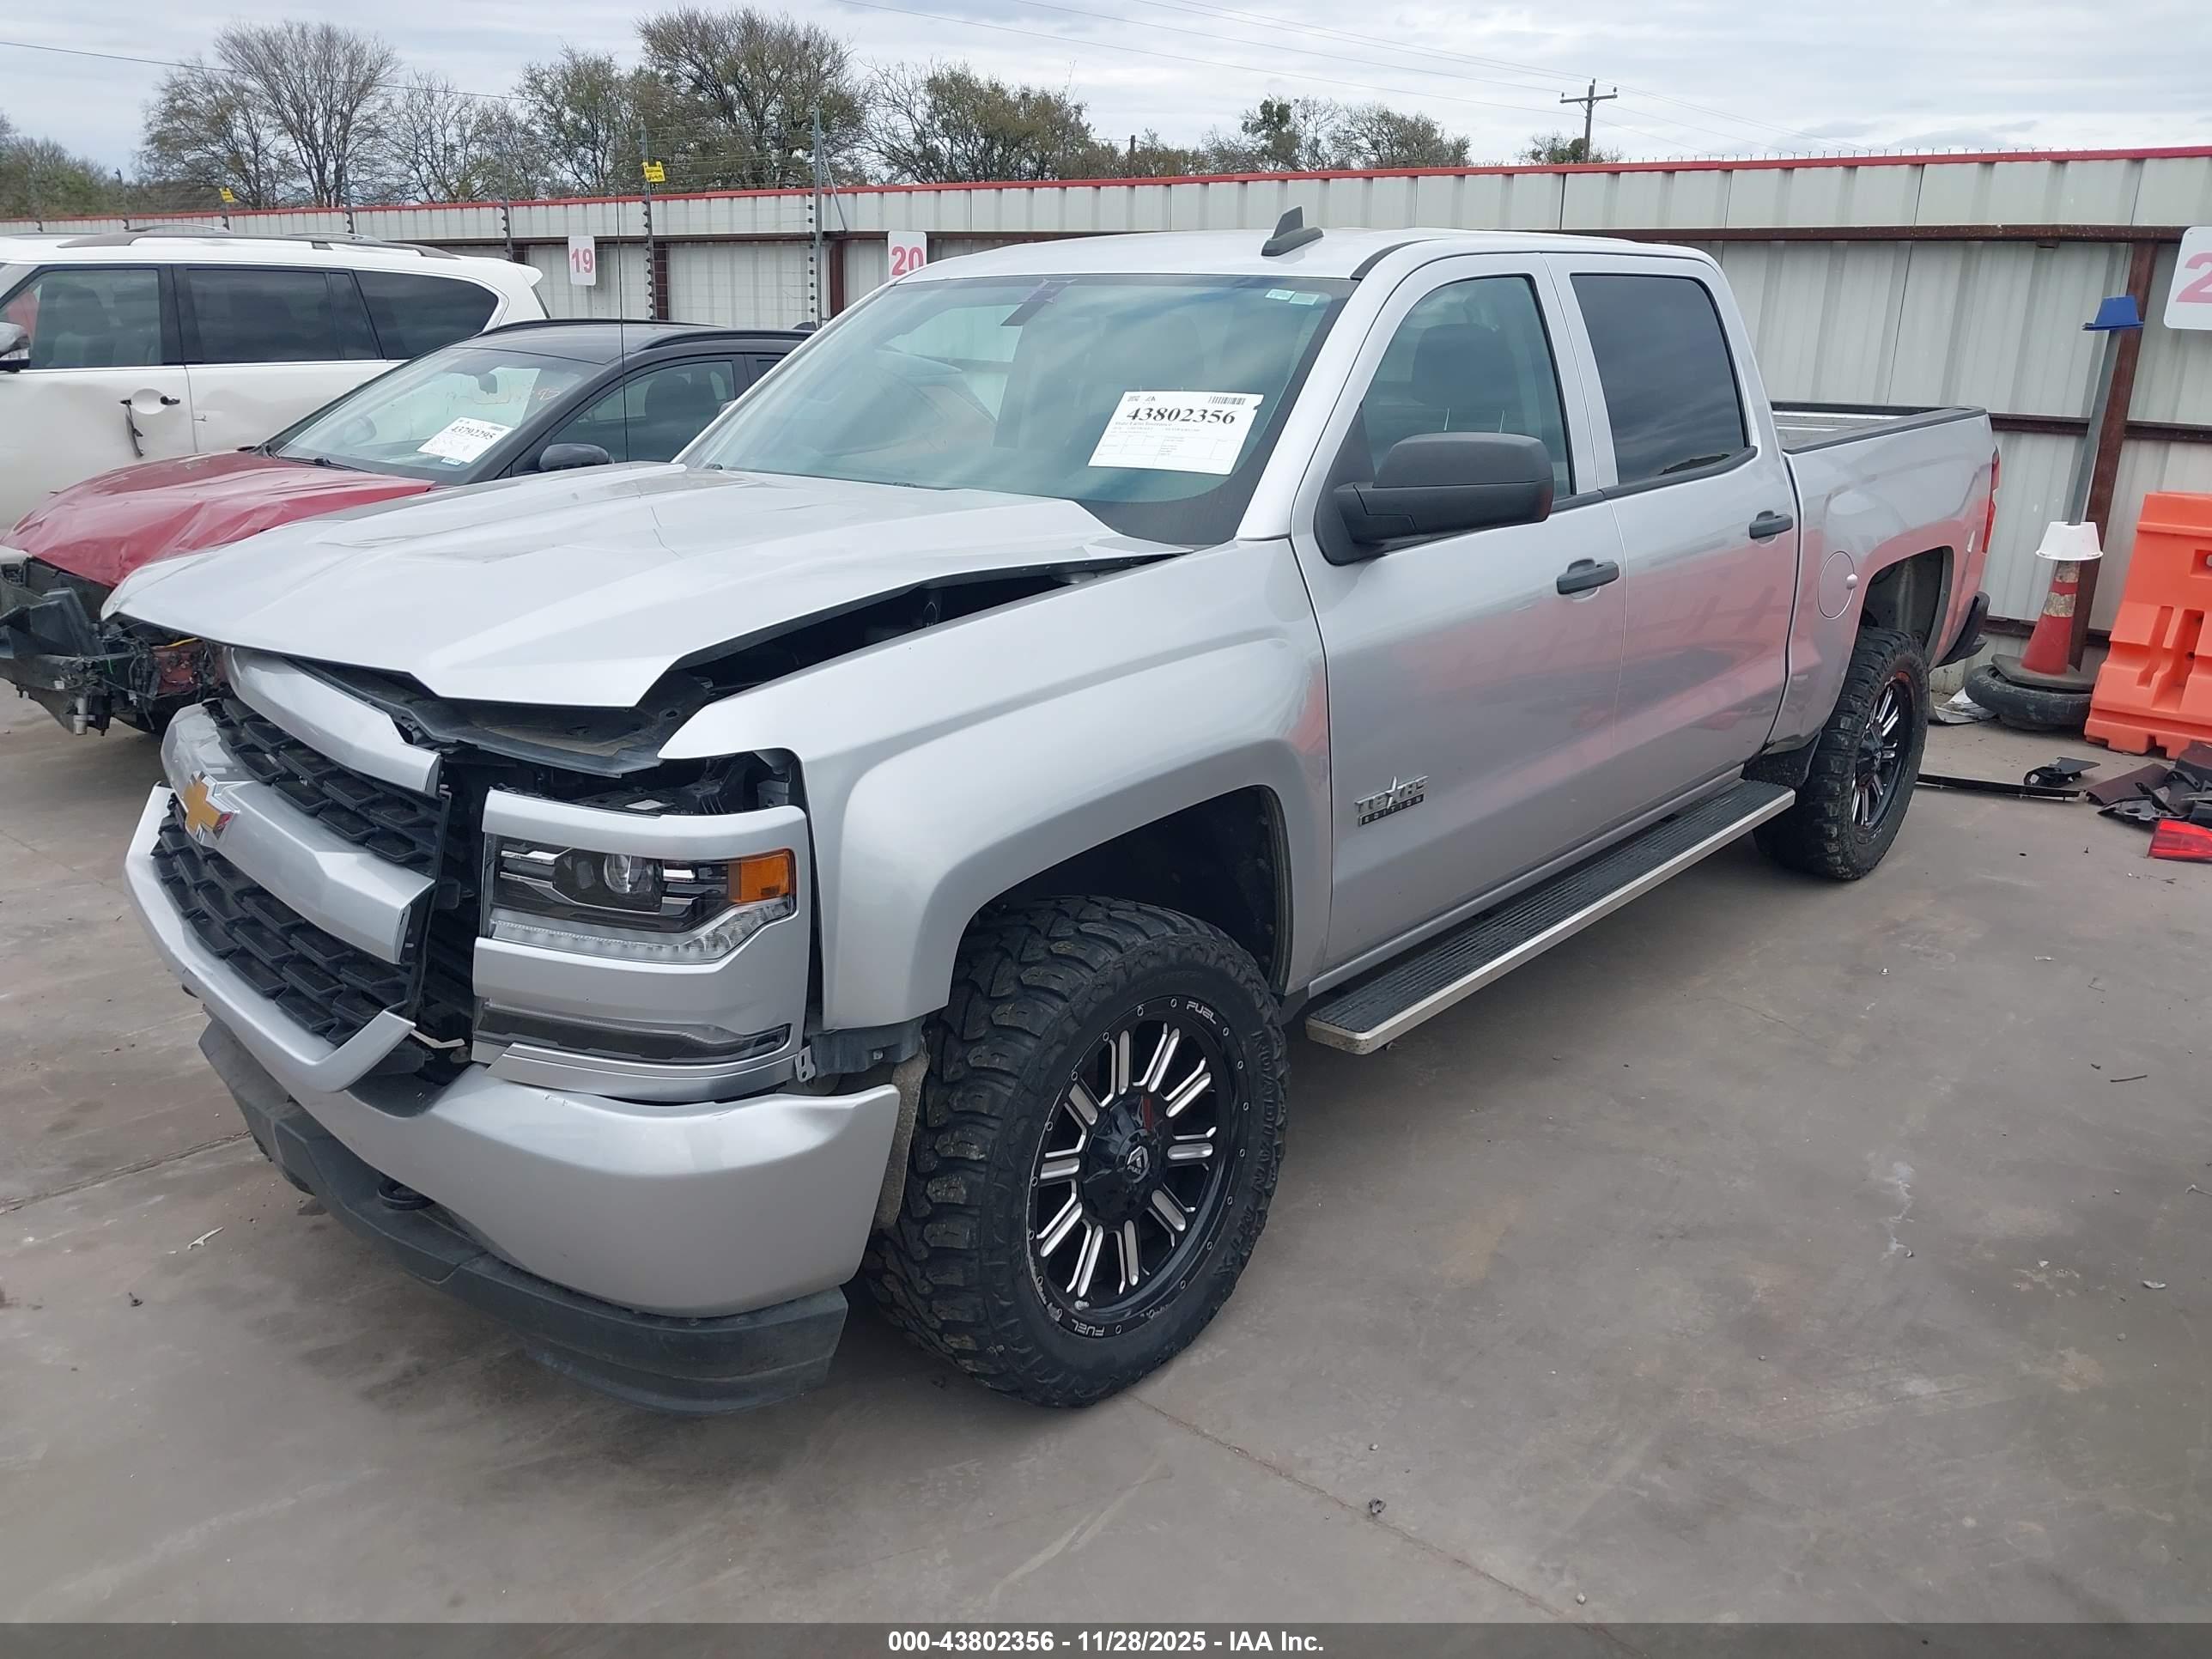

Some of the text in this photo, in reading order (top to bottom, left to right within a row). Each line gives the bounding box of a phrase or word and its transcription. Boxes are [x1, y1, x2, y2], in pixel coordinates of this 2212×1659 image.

[571, 248, 593, 273] 19
[891, 246, 924, 276] 20
[1127, 407, 1237, 424] 43802356
[1355, 775, 1429, 814] TEXAS
[1187, 1000, 1217, 1024] FUEL
[1072, 1318, 1105, 1337] FUEL
